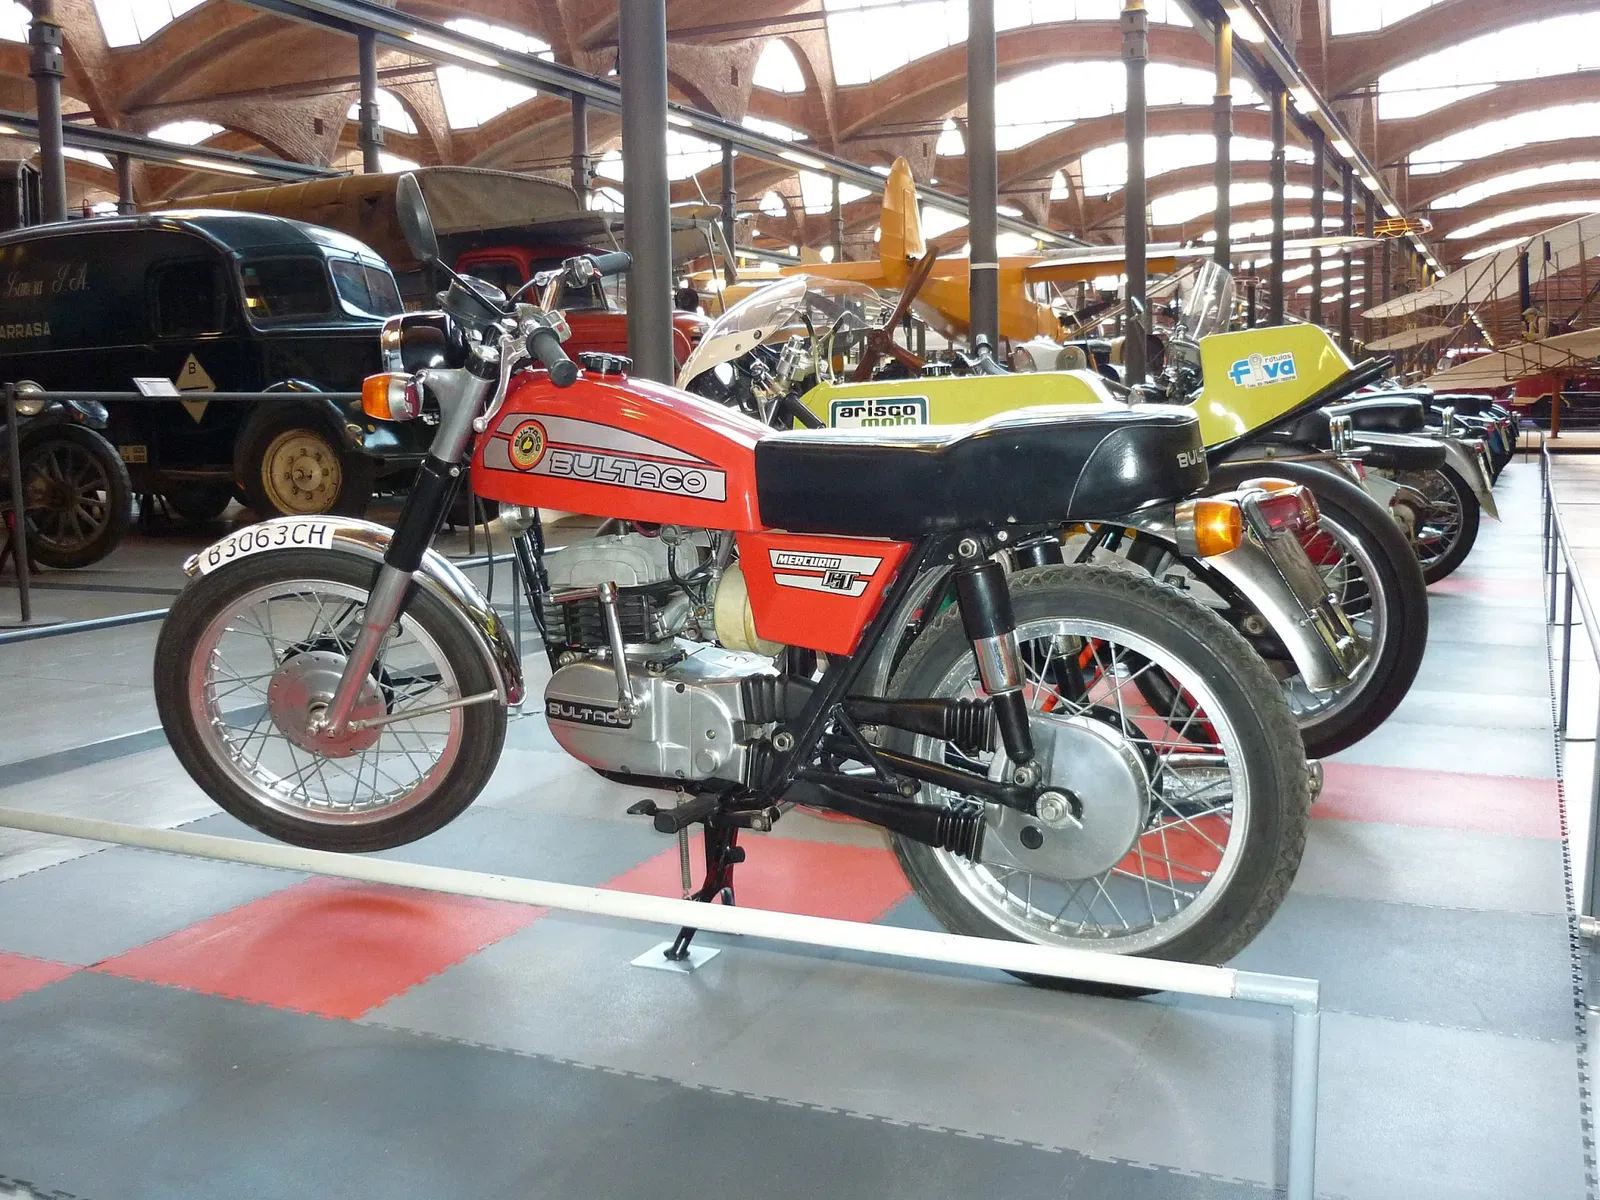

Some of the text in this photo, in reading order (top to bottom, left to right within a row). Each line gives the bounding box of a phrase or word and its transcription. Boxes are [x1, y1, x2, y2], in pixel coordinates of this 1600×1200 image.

[188, 361, 196, 375] B
[840, 400, 915, 418] arisco
[515, 427, 541, 452] BULTACO
[550, 451, 707, 493] BULTACO
[208, 524, 327, 566] B3063CH
[777, 554, 841, 568] MERCURIO
